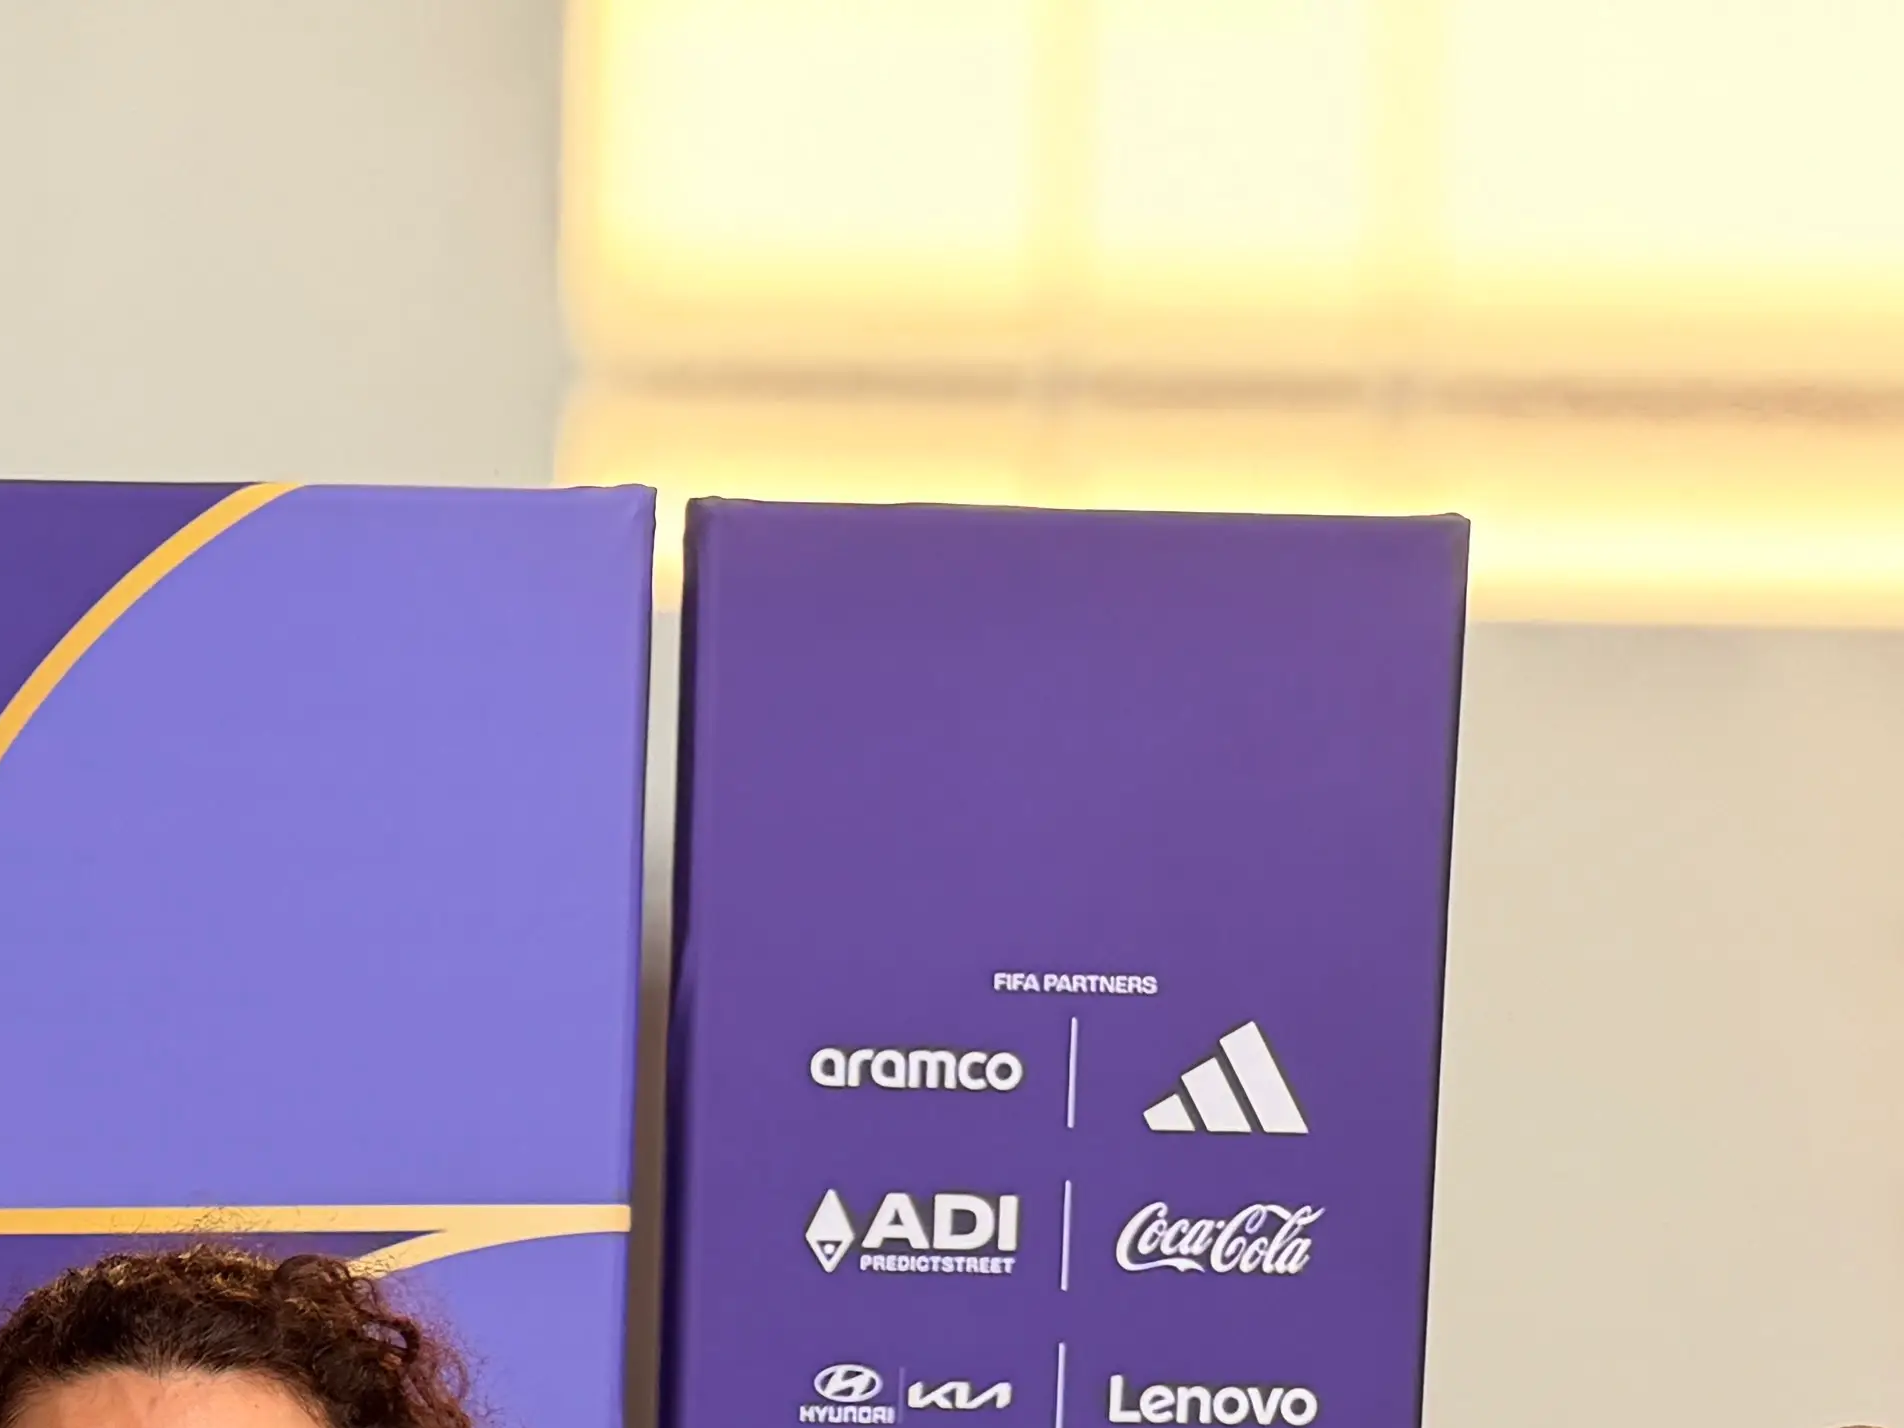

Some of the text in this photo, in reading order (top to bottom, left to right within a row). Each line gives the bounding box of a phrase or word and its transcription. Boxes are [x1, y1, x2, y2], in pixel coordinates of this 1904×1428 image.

[993, 972, 1158, 995] FIFA PARTNERS
[810, 1048, 1023, 1091] aramco
[862, 1193, 1017, 1250] ADI
[860, 1255, 1015, 1274] PREDICTSTREET
[799, 1405, 896, 1424] HYUNDAI
[1109, 1374, 1317, 1425] Lenovo
